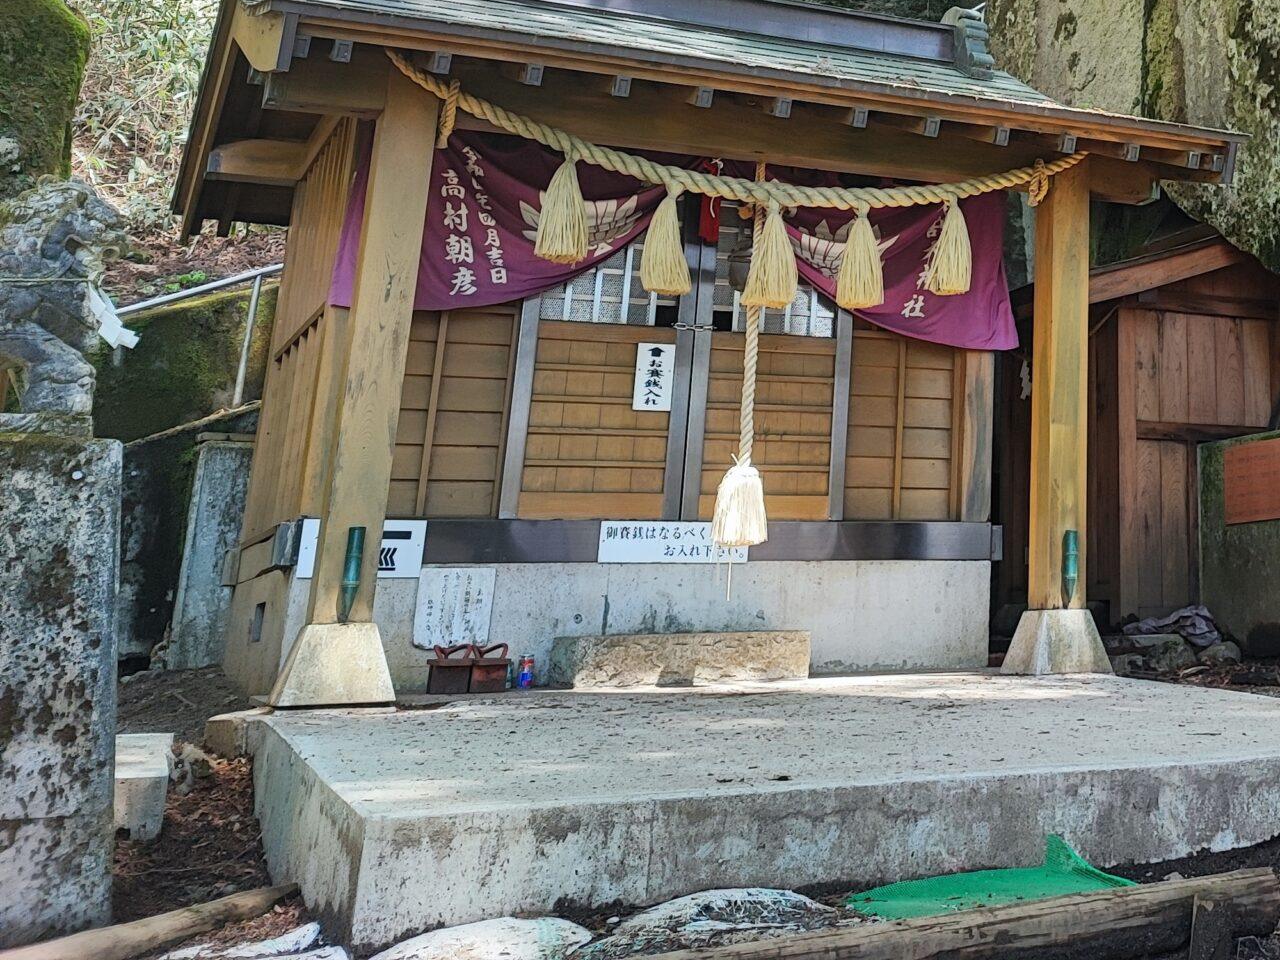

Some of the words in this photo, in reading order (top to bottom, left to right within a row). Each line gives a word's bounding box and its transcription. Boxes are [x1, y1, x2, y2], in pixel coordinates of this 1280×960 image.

[440, 168, 478, 297] 高村朝彦
[642, 359, 665, 406] お賽銭入れ
